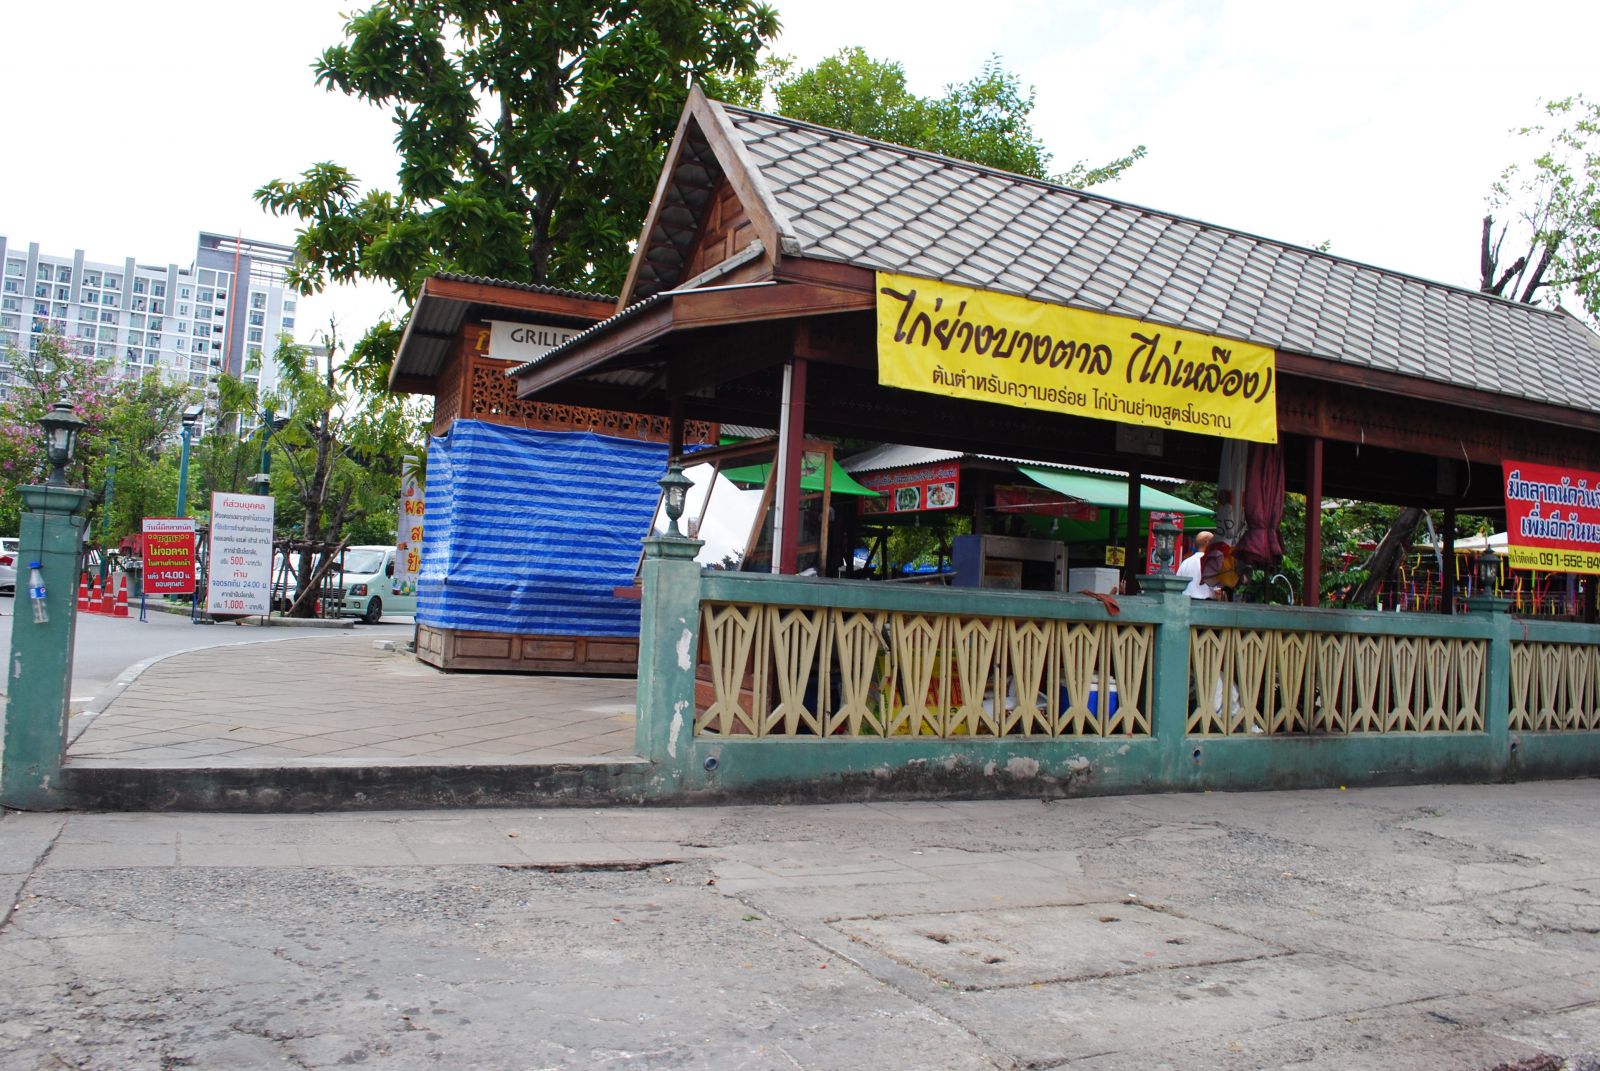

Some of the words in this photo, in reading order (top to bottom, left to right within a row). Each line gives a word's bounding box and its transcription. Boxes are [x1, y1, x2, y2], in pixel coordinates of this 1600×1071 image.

[880, 287, 1113, 376] ไก่ย่างบางตาล
[1126, 332, 1273, 404] (ไก่เหลือง)
[932, 364, 1086, 407] ต้นตำหรับความอร่อย
[1092, 387, 1232, 429] ไก่บ้านย่างสูตรโบราณ
[223, 497, 266, 511] ที่ส่วนบุคคล
[149, 544, 189, 556] ไม่จอดรถ
[1539, 552, 1600, 570] 091-552-84
[160, 571, 184, 580] 14.00
[233, 569, 248, 578] ห้าม
